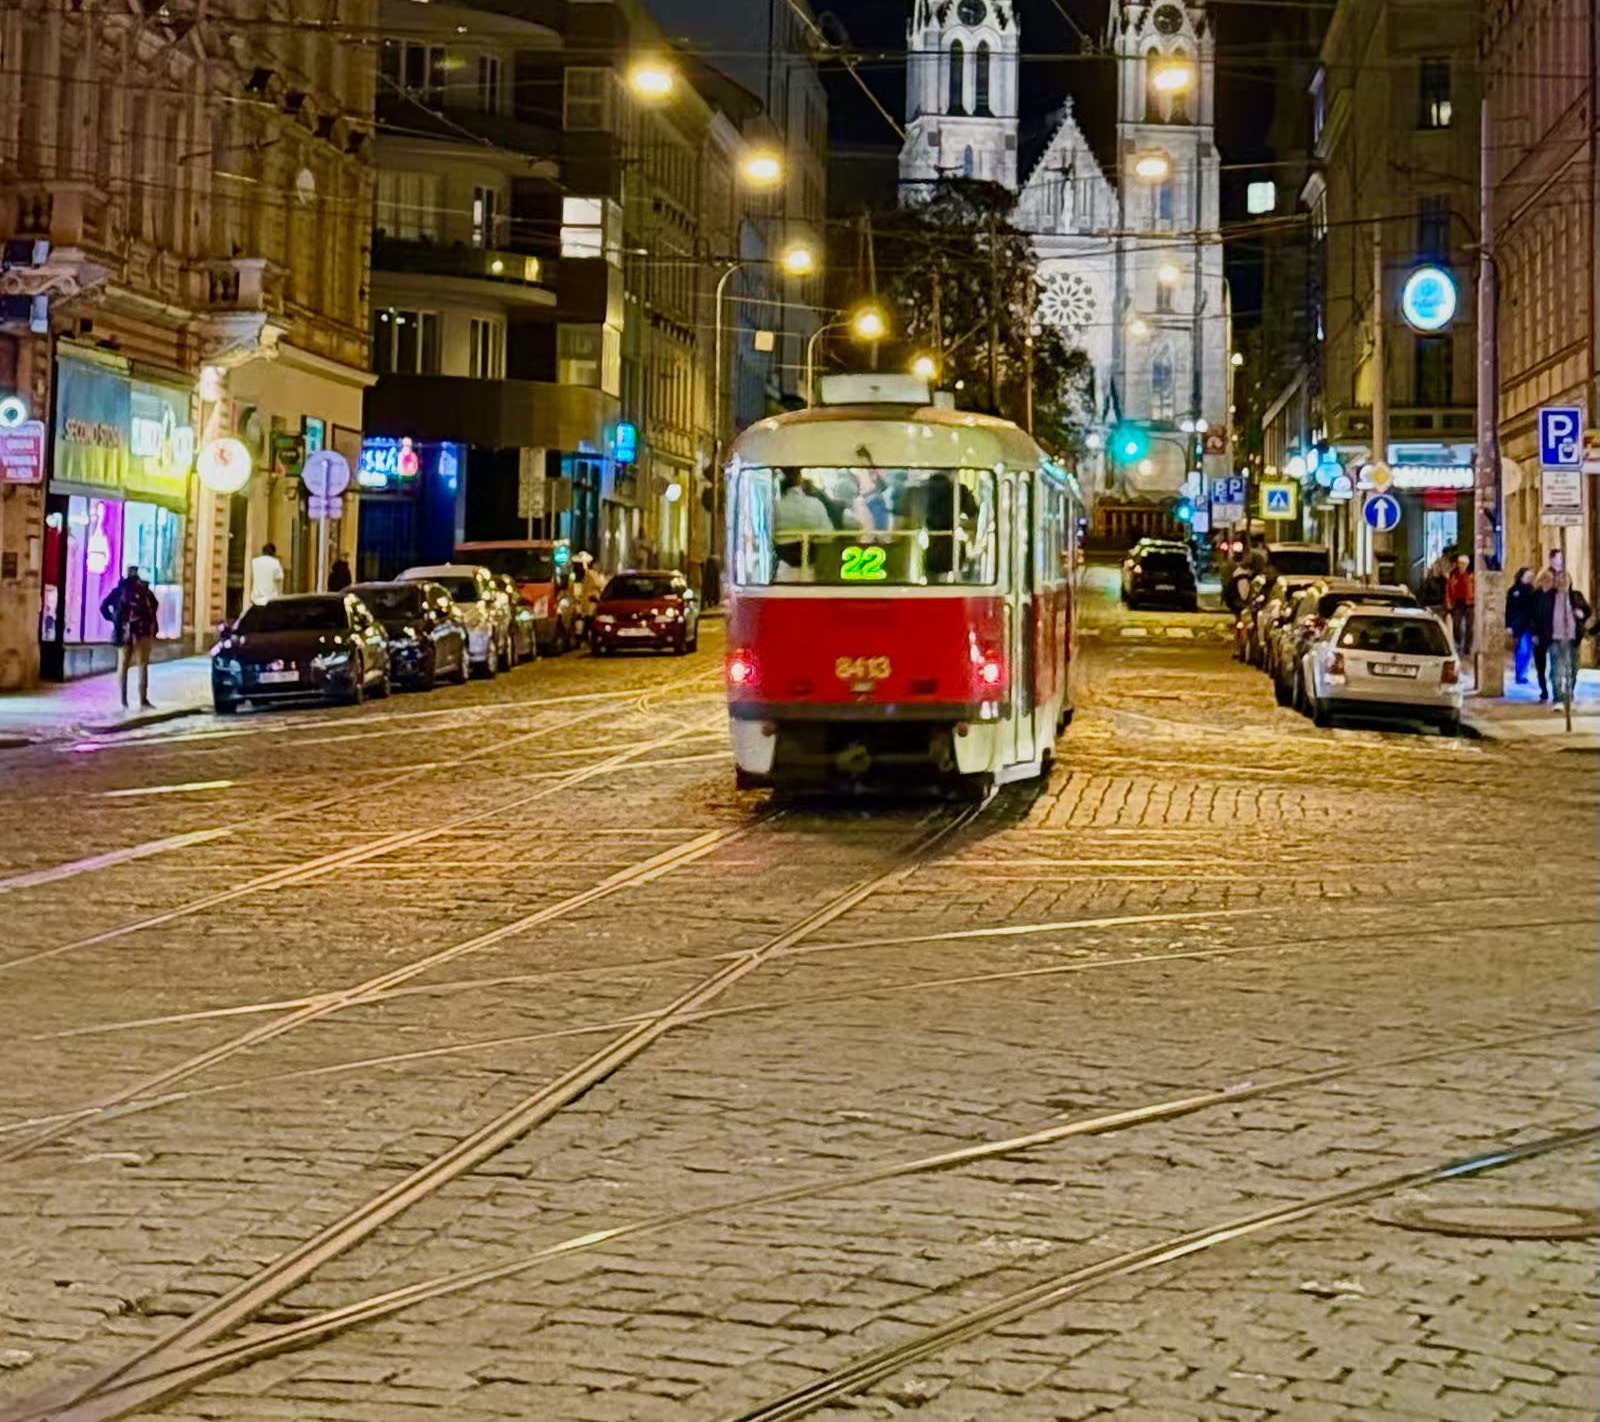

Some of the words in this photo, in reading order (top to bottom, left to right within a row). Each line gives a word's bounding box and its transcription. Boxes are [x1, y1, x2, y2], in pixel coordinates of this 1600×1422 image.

[1547, 414, 1573, 449] P
[1215, 481, 1228, 496] P
[1229, 479, 1241, 493] P
[841, 546, 887, 580] 22
